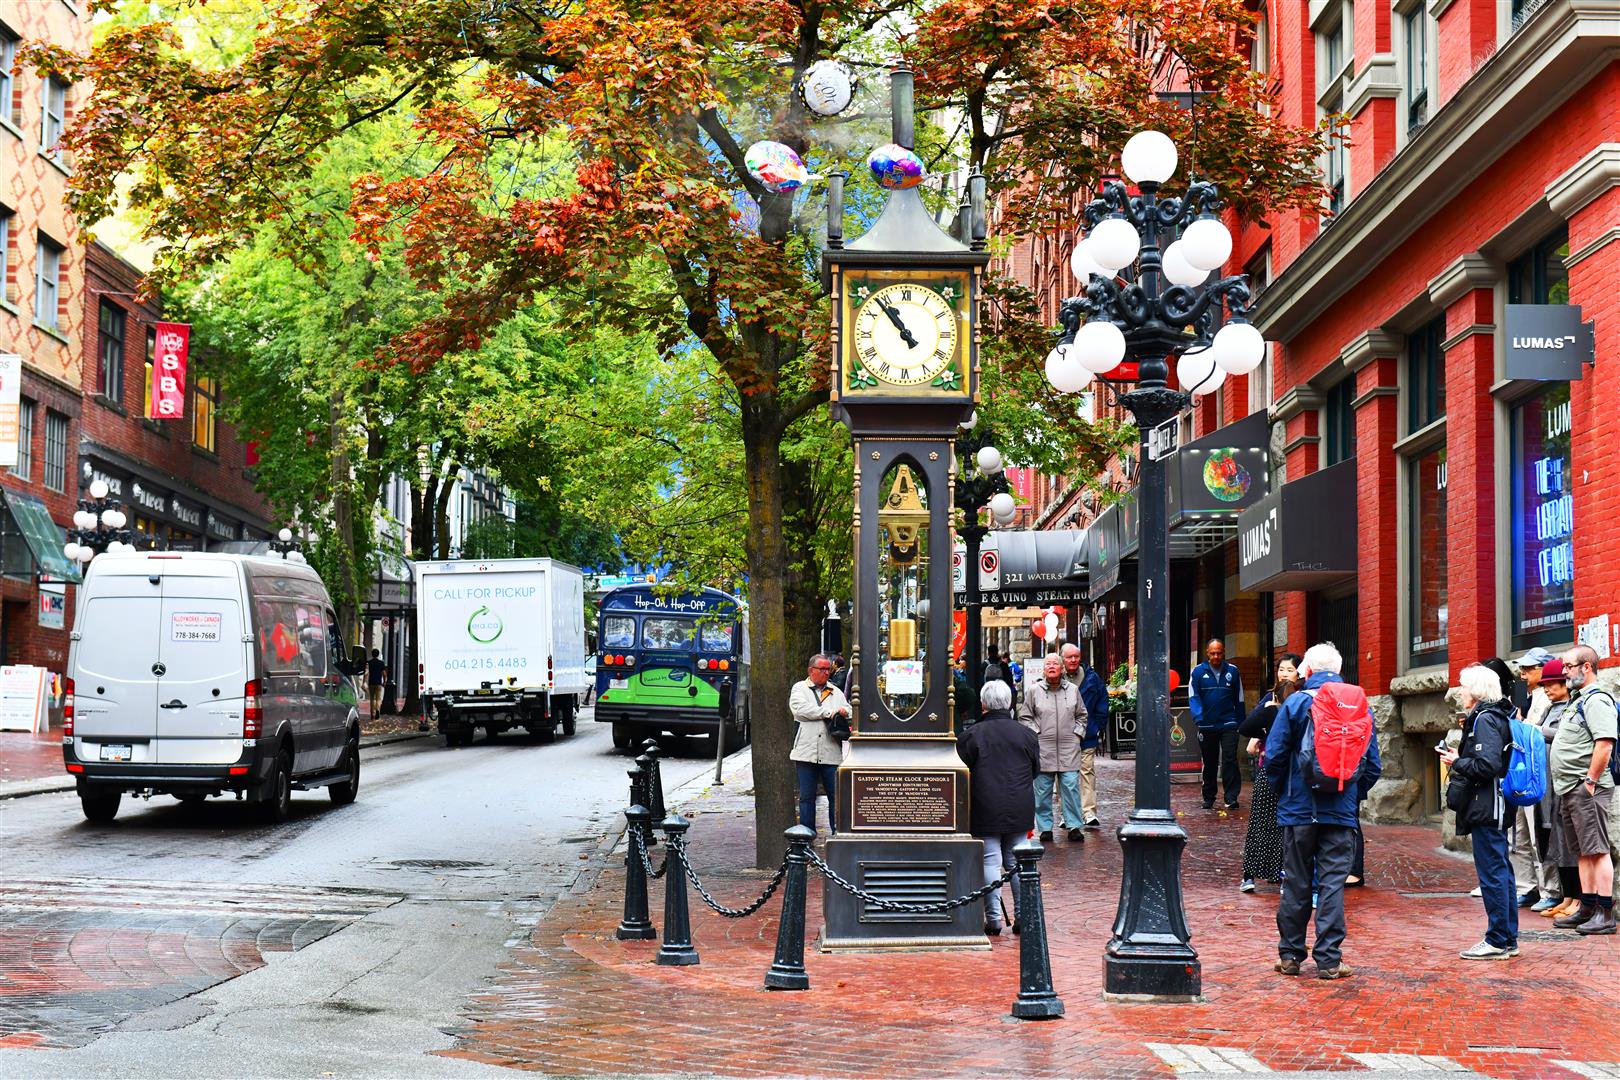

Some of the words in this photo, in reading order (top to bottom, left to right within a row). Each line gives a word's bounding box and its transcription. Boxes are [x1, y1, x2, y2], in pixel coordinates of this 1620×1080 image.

[1513, 337, 1564, 349] LUMAS
[1242, 519, 1271, 566] LUMAS
[1005, 574, 1023, 584] 321
[434, 589, 462, 600] CALL
[466, 588, 490, 598] FOR
[495, 587, 536, 598] PICKUP
[1002, 592, 1027, 603] VINO
[1037, 590, 1070, 601] STEAK
[671, 598, 706, 611] Hop-Off
[444, 657, 527, 670] 604.215.4483
